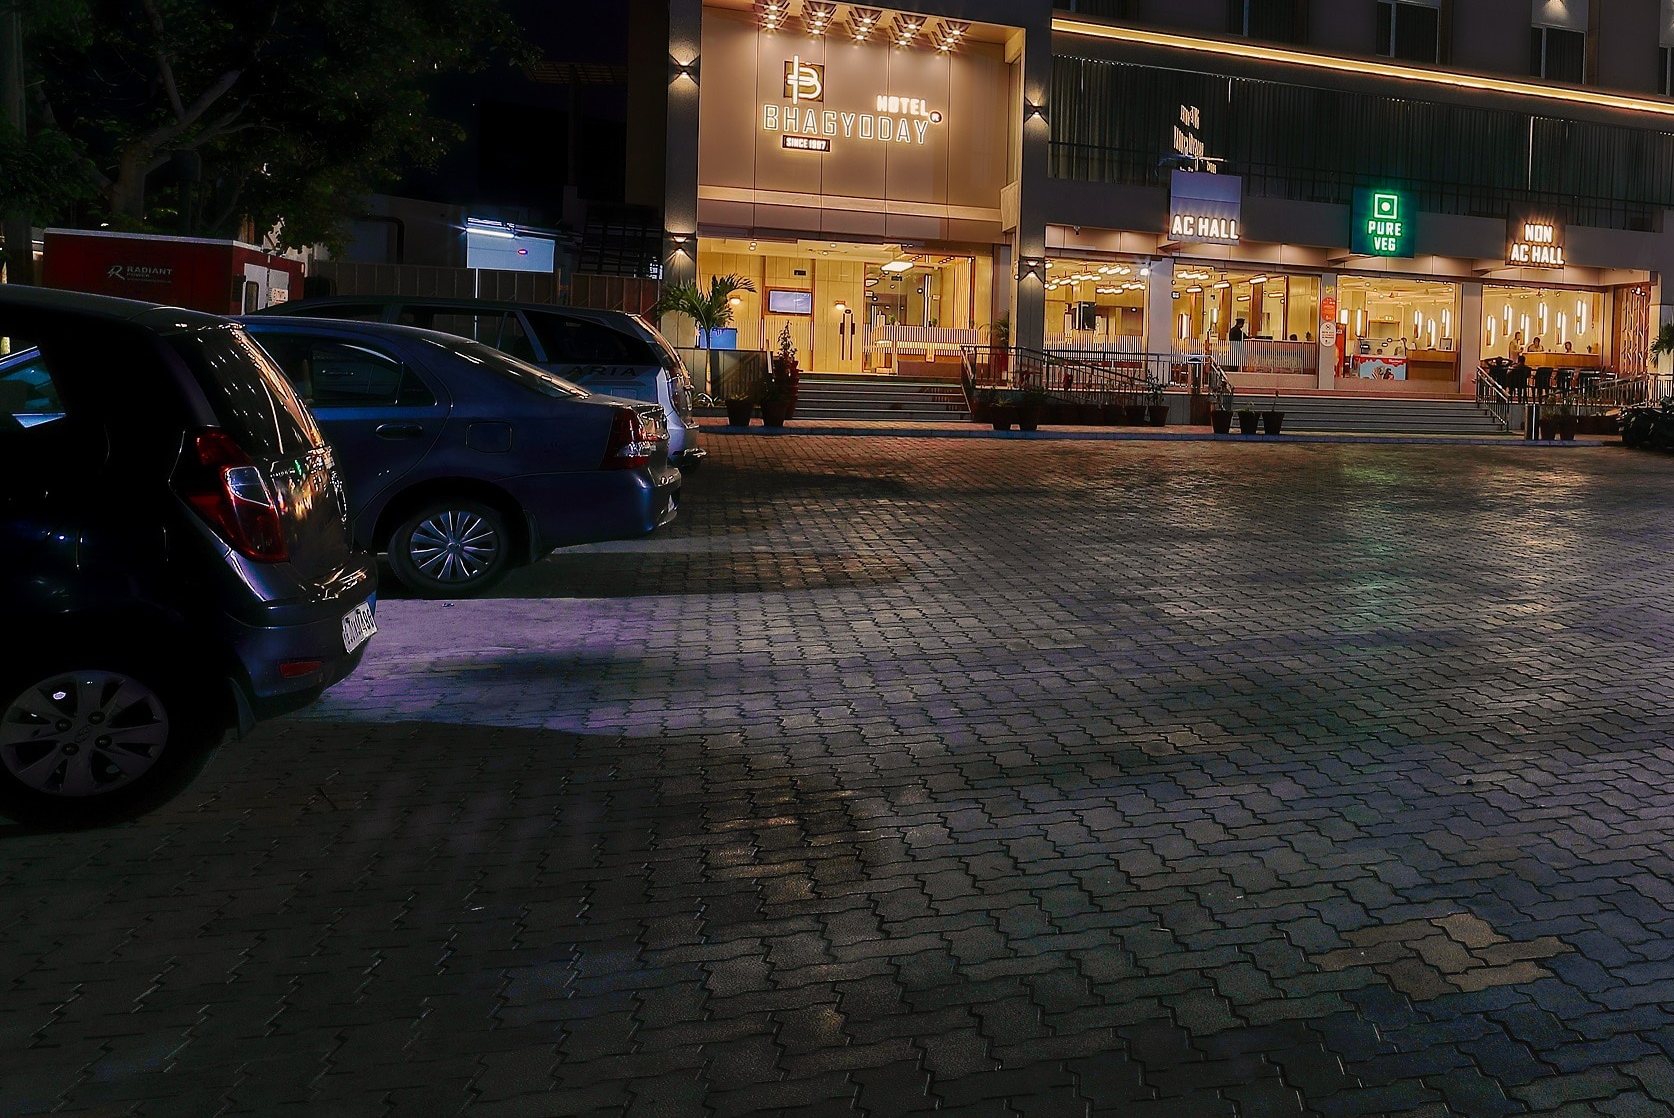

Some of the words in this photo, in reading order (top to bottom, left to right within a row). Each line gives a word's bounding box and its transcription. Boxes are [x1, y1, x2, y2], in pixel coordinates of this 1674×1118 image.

[876, 94, 929, 117] HOTEL
[763, 104, 929, 145] BHAGYODAY
[785, 137, 808, 149] SINCE
[1171, 214, 1194, 236] AC
[1197, 216, 1240, 240] HALL
[1368, 220, 1402, 237] PURE
[1524, 223, 1553, 243] NON
[1373, 236, 1396, 252] VEG
[1510, 243, 1530, 262] AC
[1531, 245, 1565, 265] HALL
[126, 265, 173, 275] RADIANT
